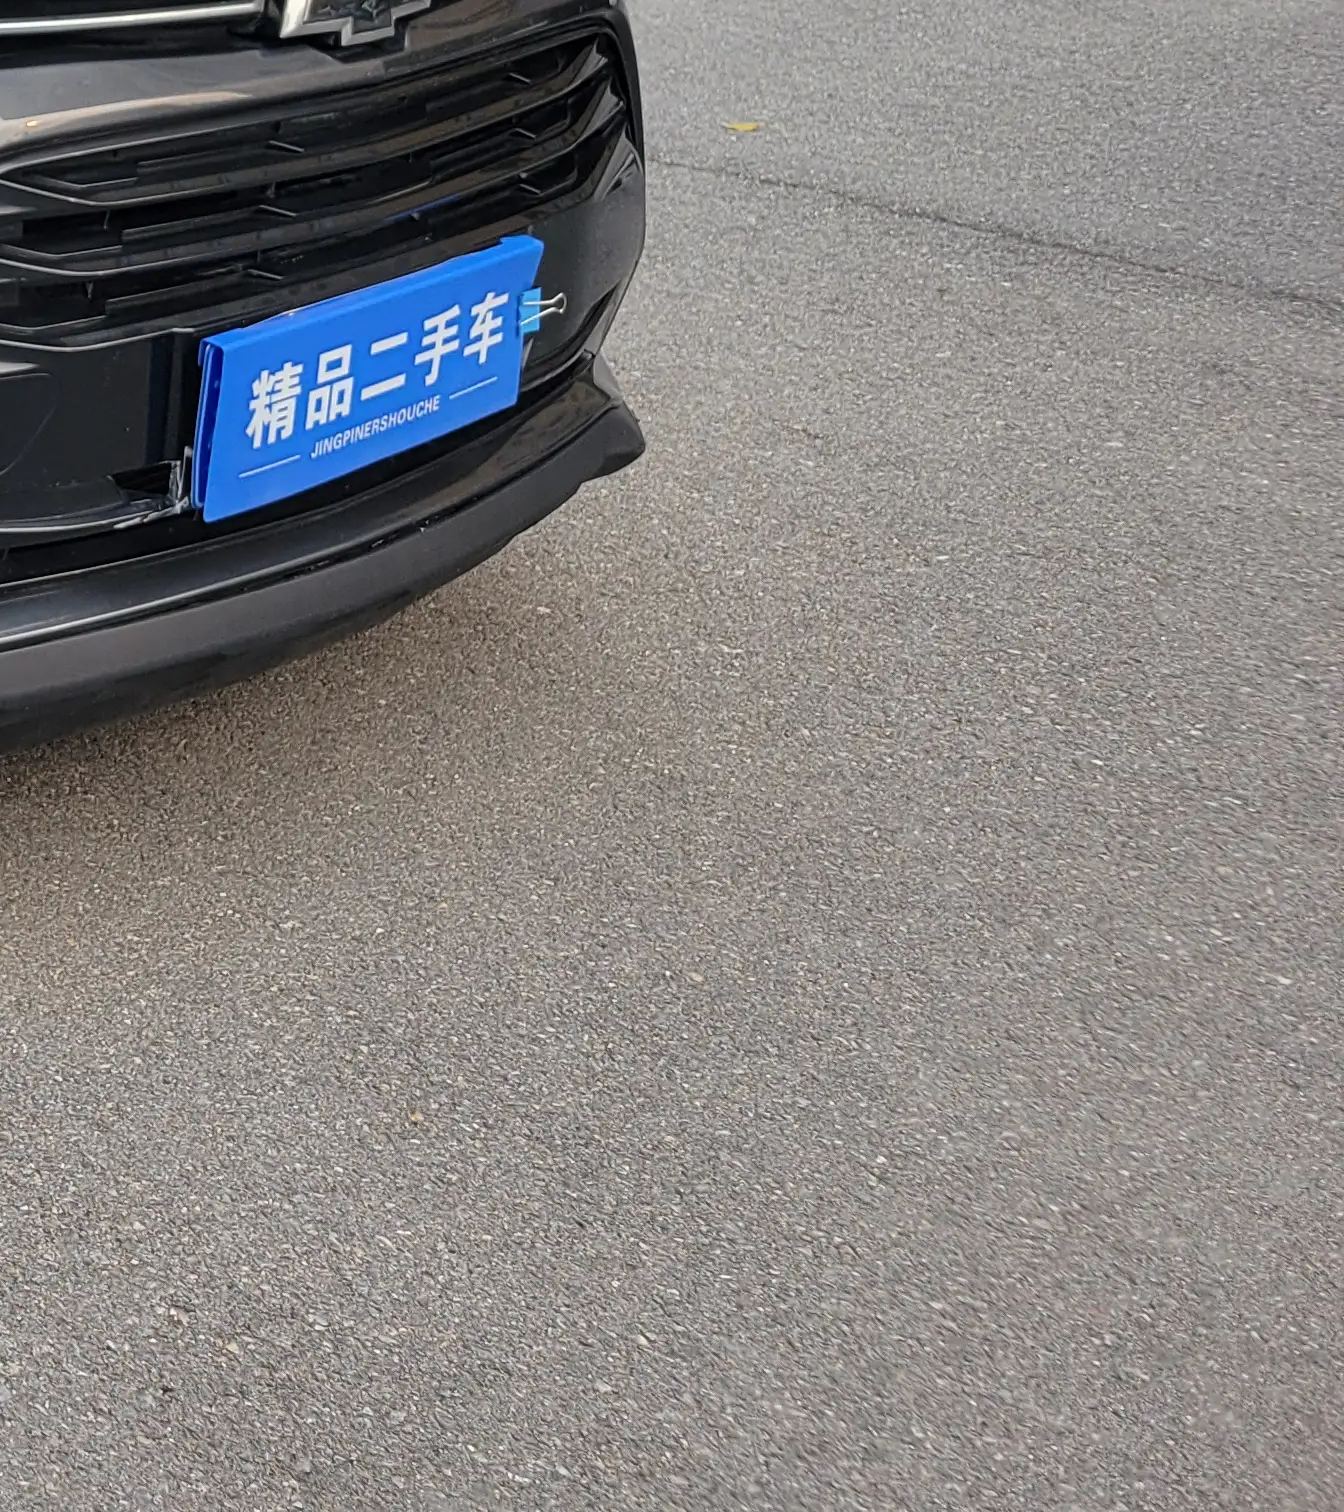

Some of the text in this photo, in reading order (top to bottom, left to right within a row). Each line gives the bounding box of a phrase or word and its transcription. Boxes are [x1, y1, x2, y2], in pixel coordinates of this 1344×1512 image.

[245, 291, 509, 449] 精品二手车
[310, 394, 441, 459] JINGPINERSHOUCHE
